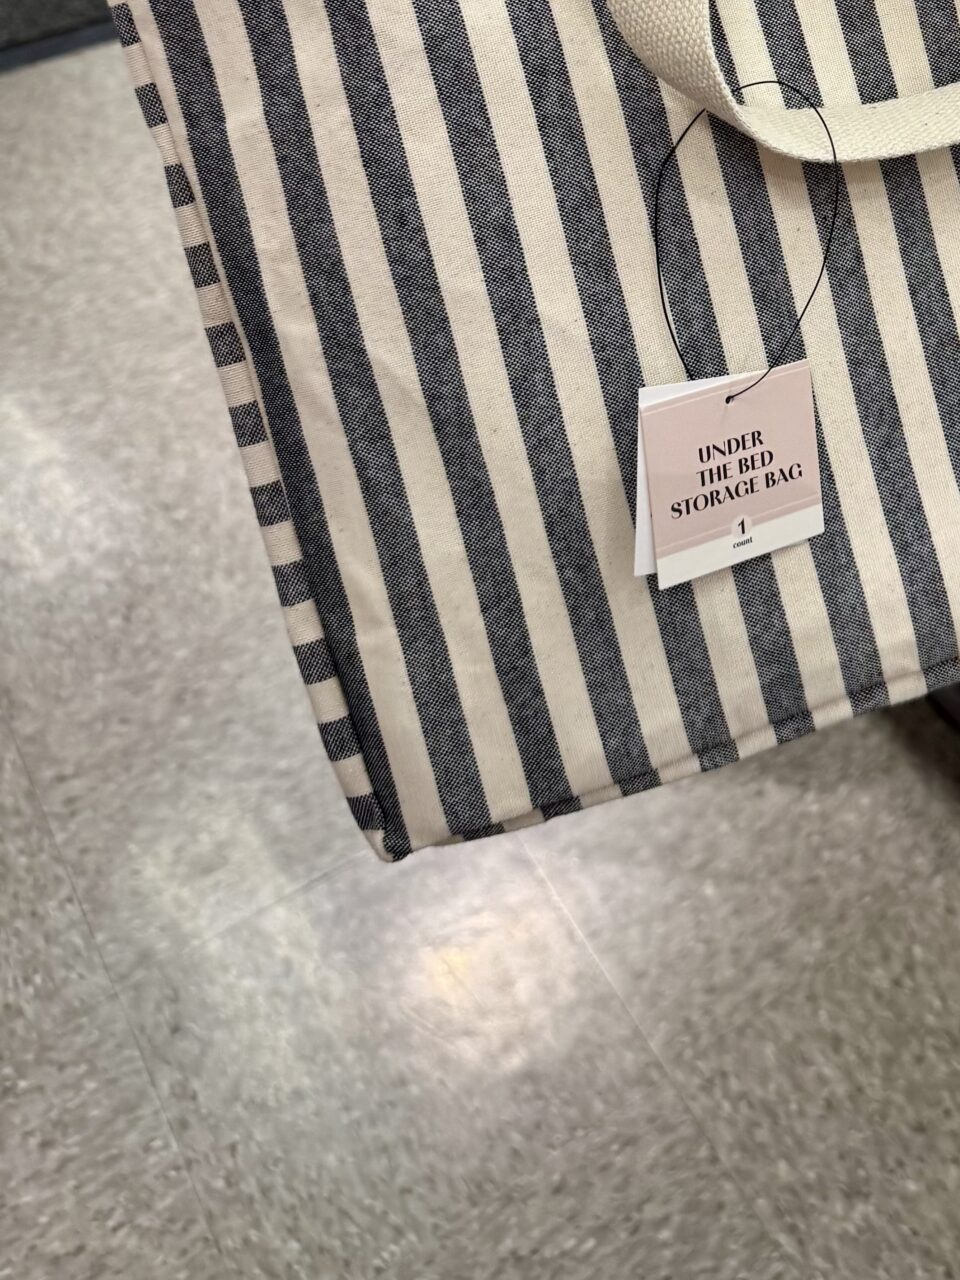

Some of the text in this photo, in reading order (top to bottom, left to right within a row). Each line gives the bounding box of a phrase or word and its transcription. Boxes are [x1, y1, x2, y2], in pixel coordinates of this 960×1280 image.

[698, 430, 764, 463] UNDER
[696, 450, 774, 487] THE BED
[670, 463, 803, 520] STORAGE BAG
[732, 536, 753, 549] count
[737, 517, 746, 535] 1
